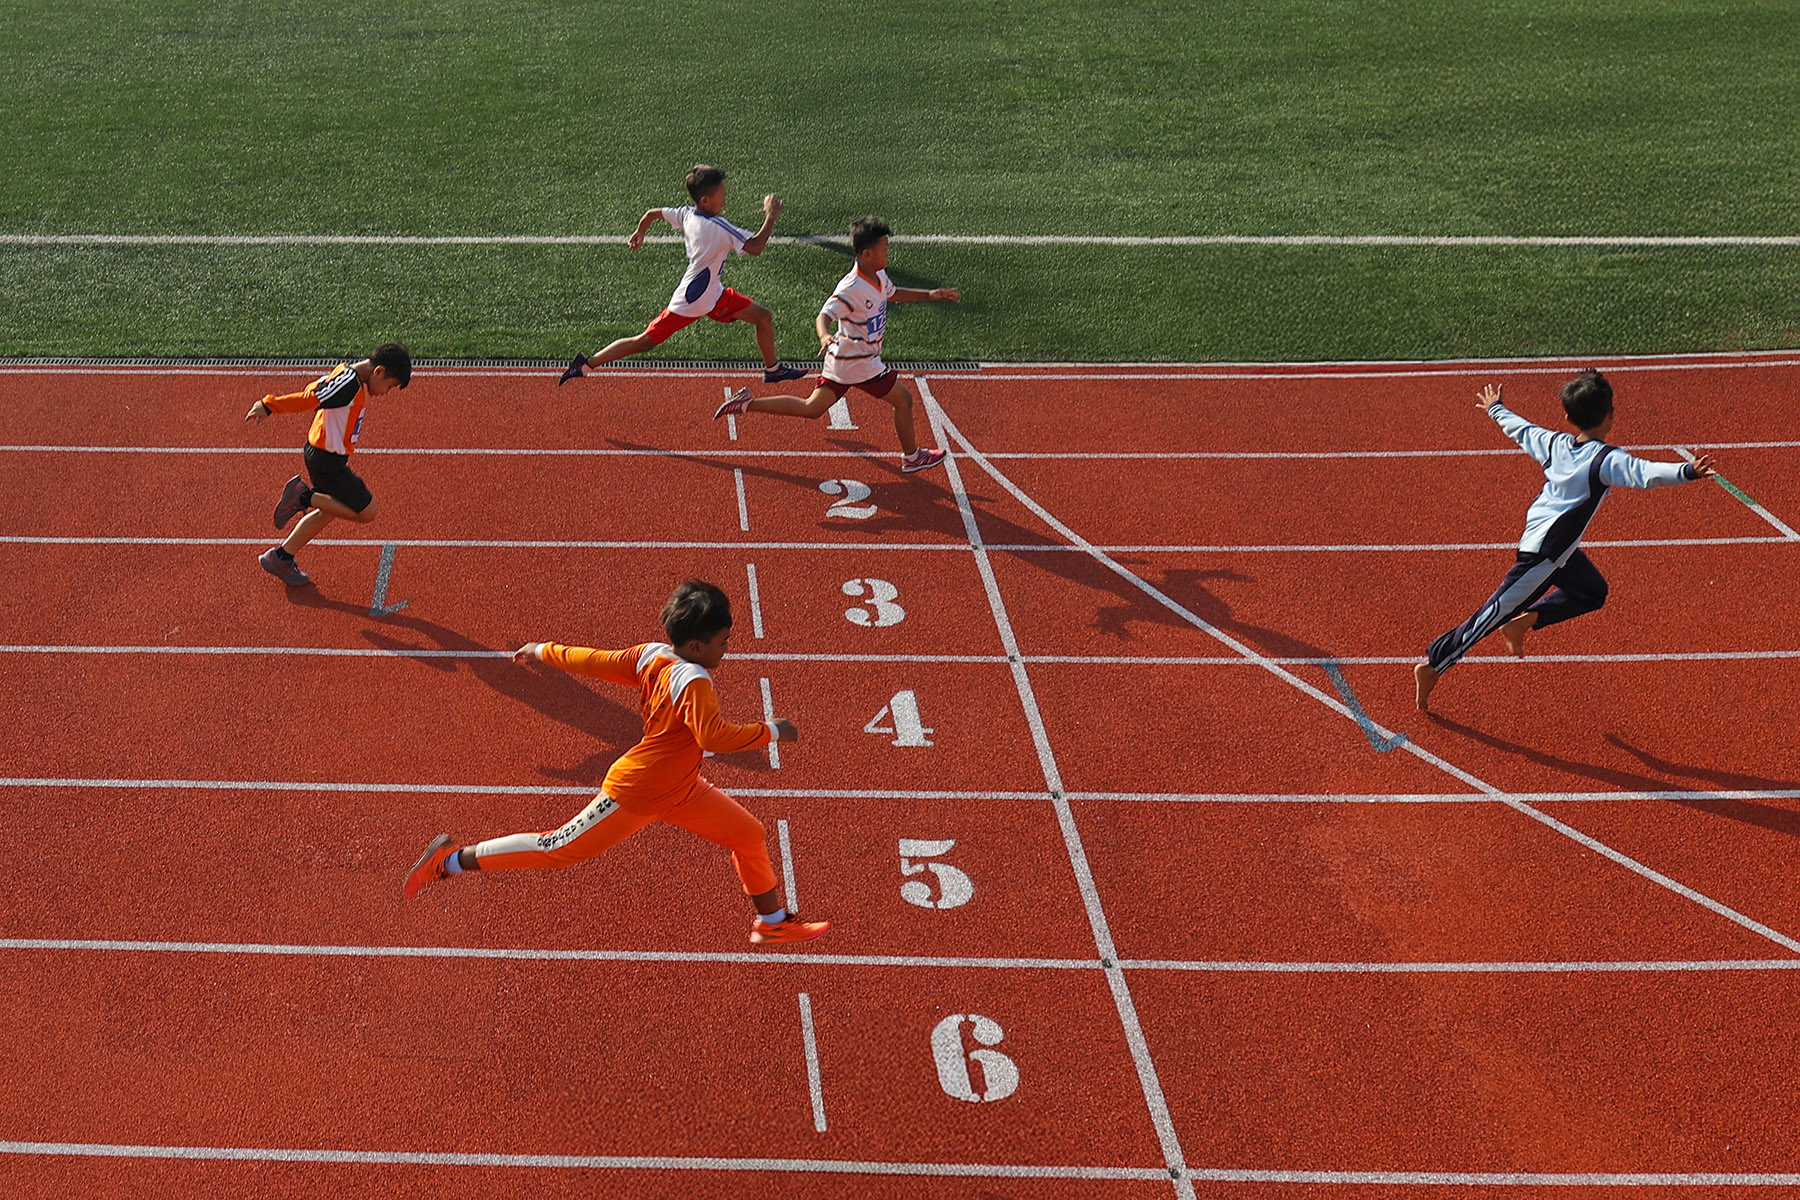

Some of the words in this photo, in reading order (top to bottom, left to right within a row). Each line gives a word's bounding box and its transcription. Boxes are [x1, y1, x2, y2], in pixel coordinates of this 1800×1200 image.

[827, 396, 860, 430] 1
[819, 479, 877, 520] 2
[843, 578, 906, 628] 3
[864, 690, 935, 747] 4
[898, 839, 976, 910] 5
[931, 1014, 1020, 1104] 6
